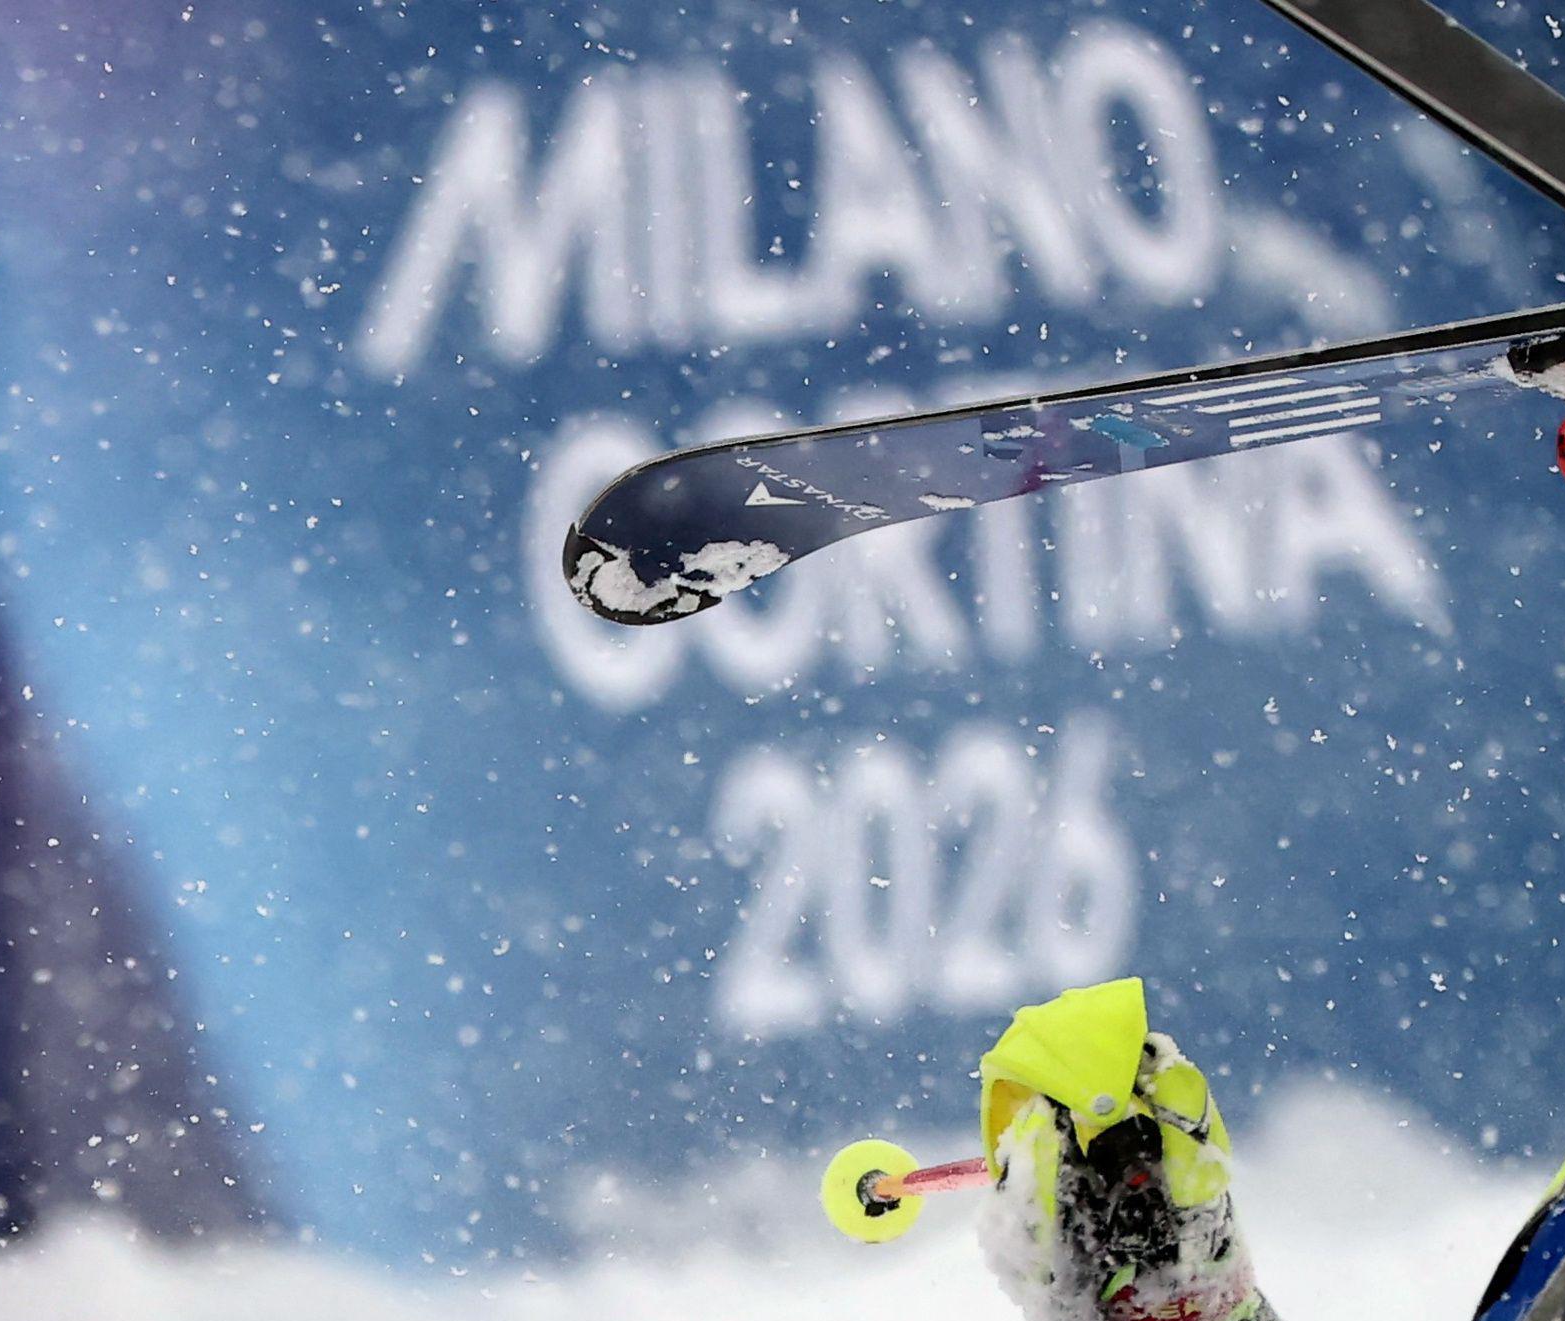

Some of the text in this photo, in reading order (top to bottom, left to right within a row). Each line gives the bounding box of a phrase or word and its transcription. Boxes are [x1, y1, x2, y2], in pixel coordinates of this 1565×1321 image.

[359, 22, 1225, 378] MILANO
[737, 455, 886, 520] DYNASTAR
[716, 715, 1138, 1033] 2026
